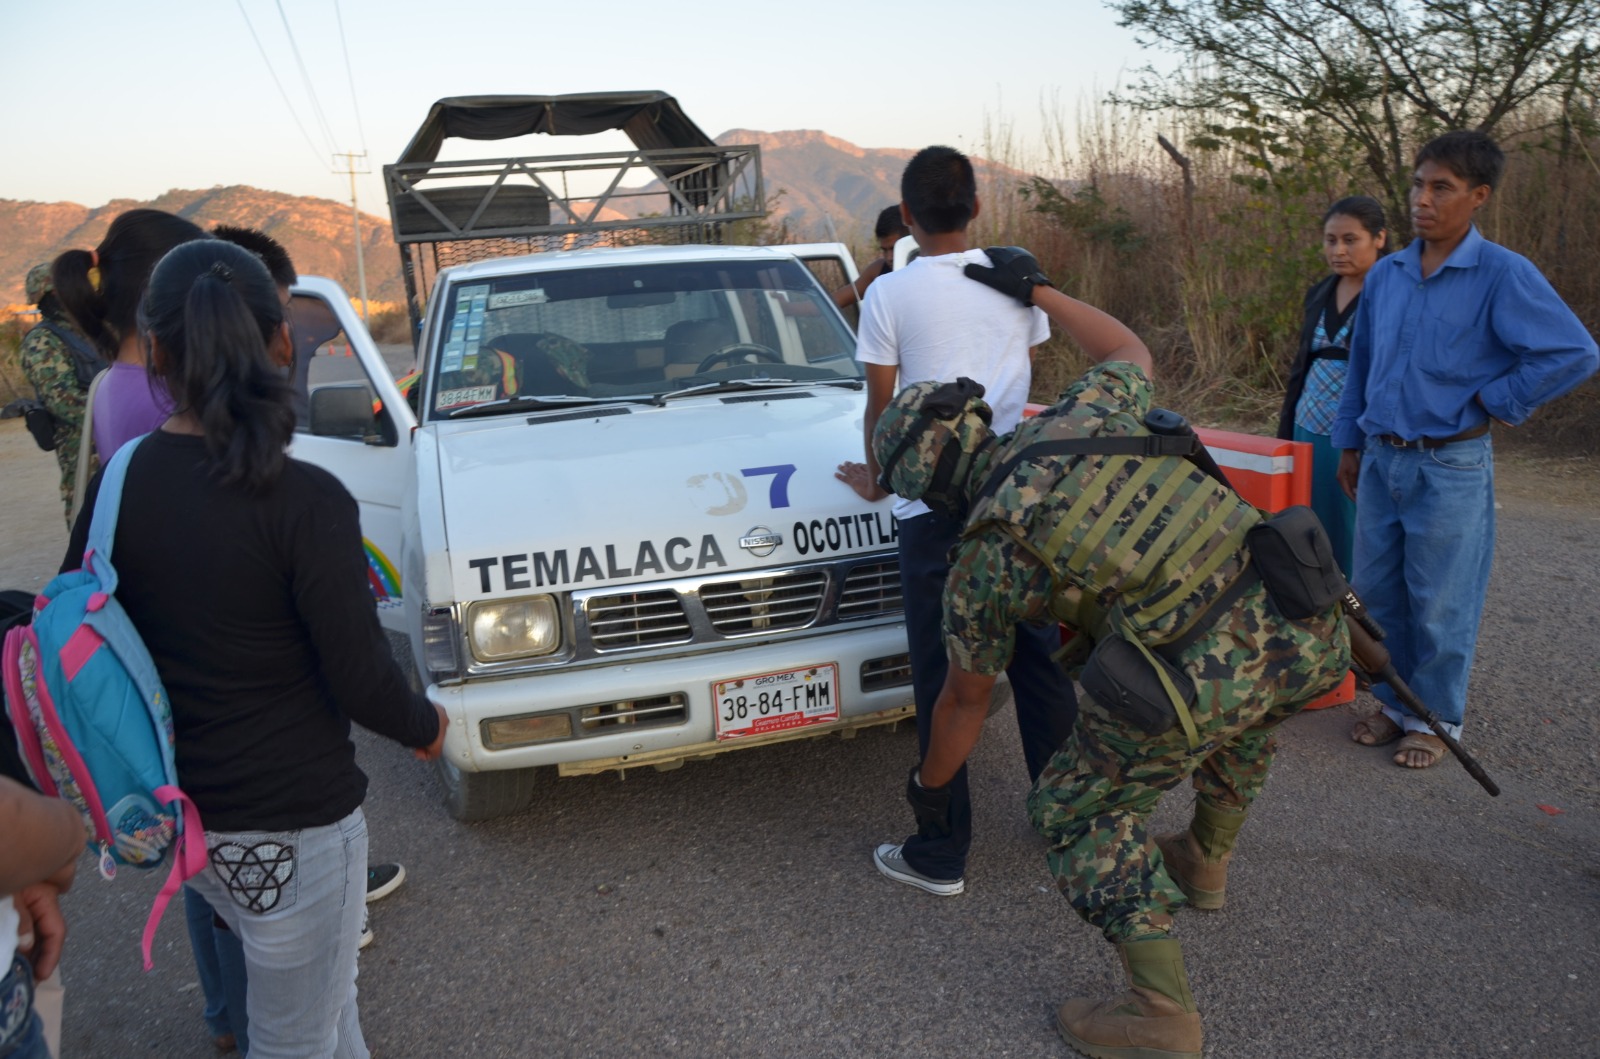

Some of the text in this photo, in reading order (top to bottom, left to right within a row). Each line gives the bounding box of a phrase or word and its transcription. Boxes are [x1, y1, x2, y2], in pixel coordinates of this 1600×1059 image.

[469, 533, 727, 593] TEMALACA
[755, 676, 775, 686] GRO
[776, 672, 796, 681] MEX
